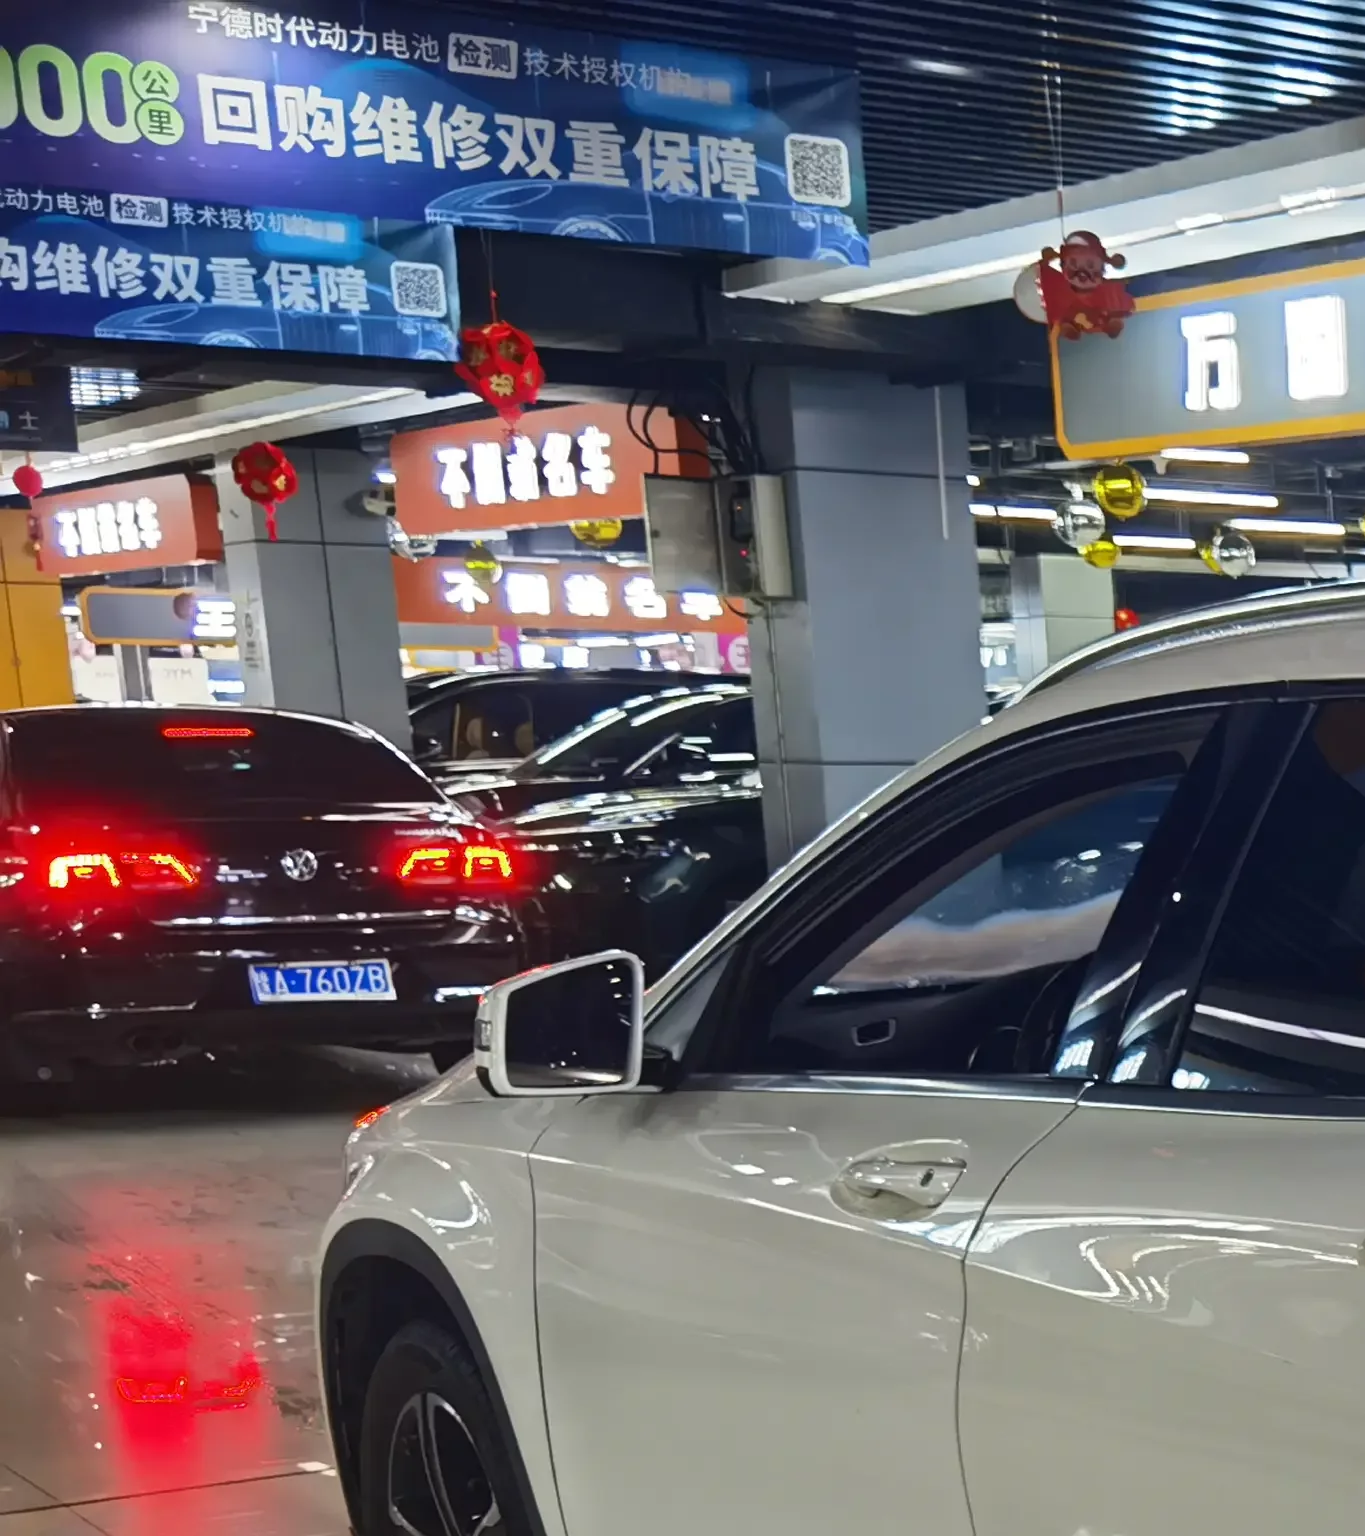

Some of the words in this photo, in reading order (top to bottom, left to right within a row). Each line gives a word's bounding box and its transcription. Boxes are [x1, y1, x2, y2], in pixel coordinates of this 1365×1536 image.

[0, 43, 142, 144] 00
[196, 73, 760, 201] 回购维修双重保障
